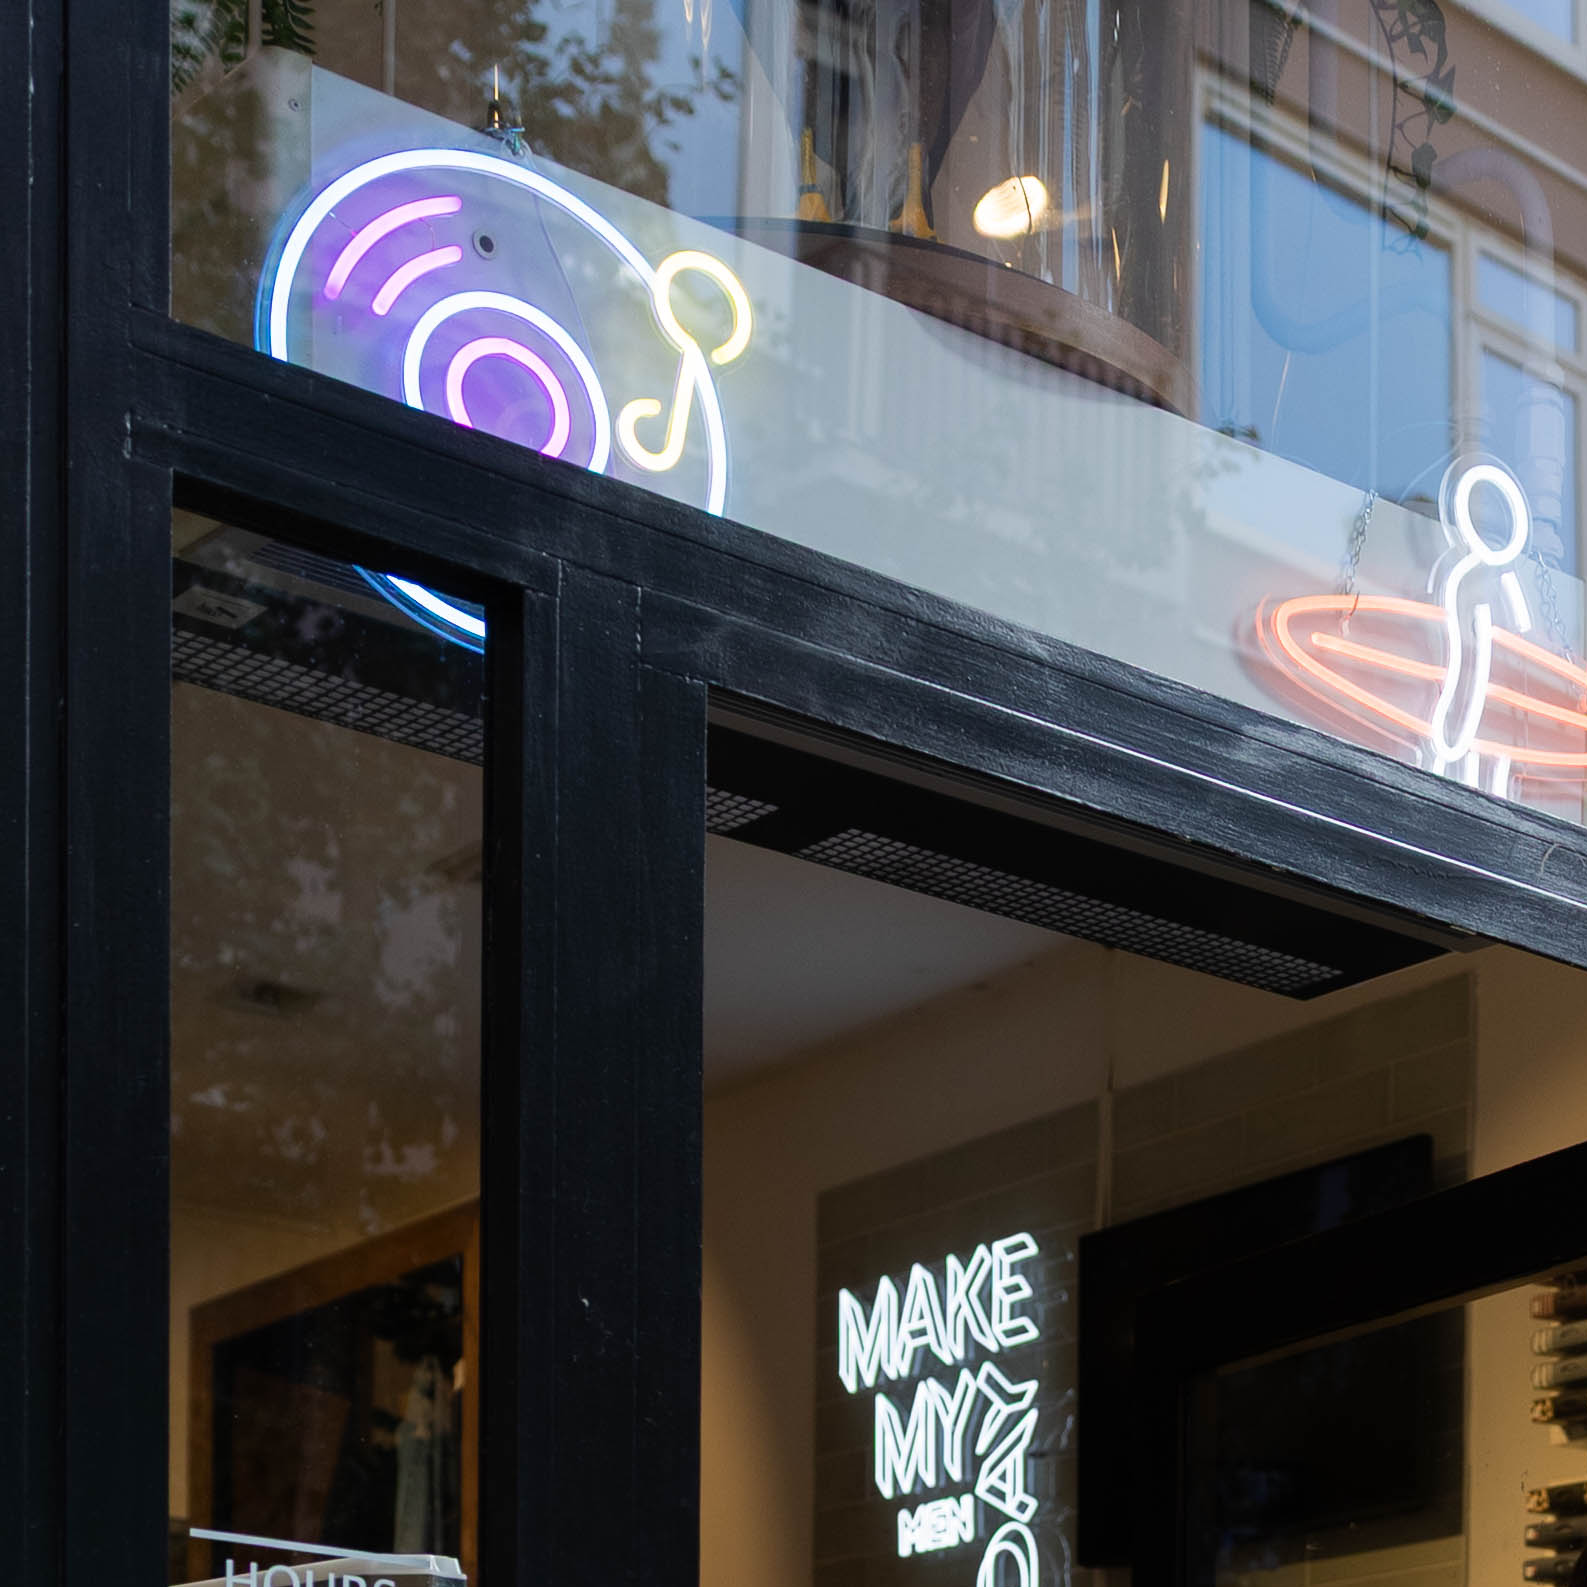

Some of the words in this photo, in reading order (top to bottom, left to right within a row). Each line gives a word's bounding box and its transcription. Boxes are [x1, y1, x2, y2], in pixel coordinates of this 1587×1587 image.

[839, 1232, 1039, 1394] MAKE
[874, 1367, 977, 1500] MY
[897, 1493, 974, 1558] MEN
